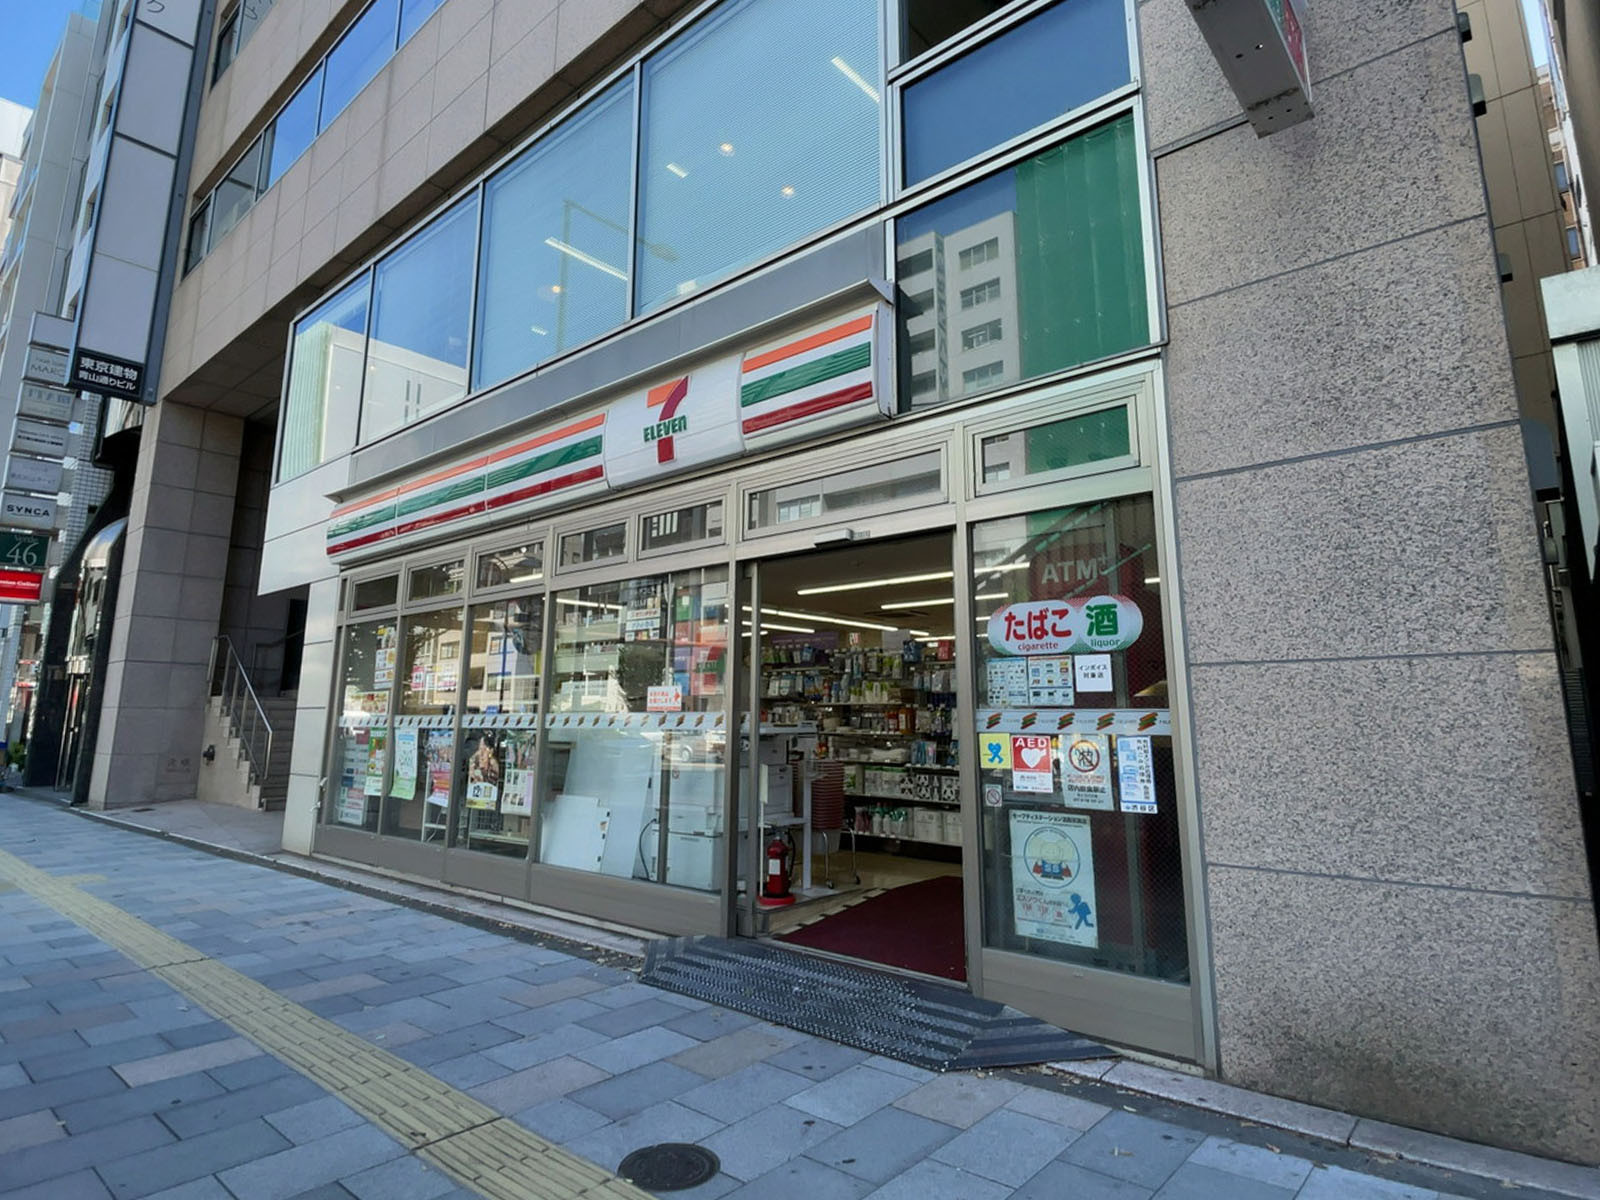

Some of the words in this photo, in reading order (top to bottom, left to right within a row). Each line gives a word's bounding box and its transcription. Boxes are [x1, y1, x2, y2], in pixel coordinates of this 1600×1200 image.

[80, 357, 138, 380] 東京建物
[78, 370, 136, 390] 青山通りビル
[7, 504, 50, 516] SYNCA
[6, 542, 39, 566] 46
[1041, 560, 1097, 585] ATM
[1004, 606, 1072, 641] たばこ
[1085, 603, 1119, 636] 酒
[1017, 640, 1059, 651] cigarette
[1090, 638, 1121, 648] liquor
[1015, 737, 1048, 748] AED
